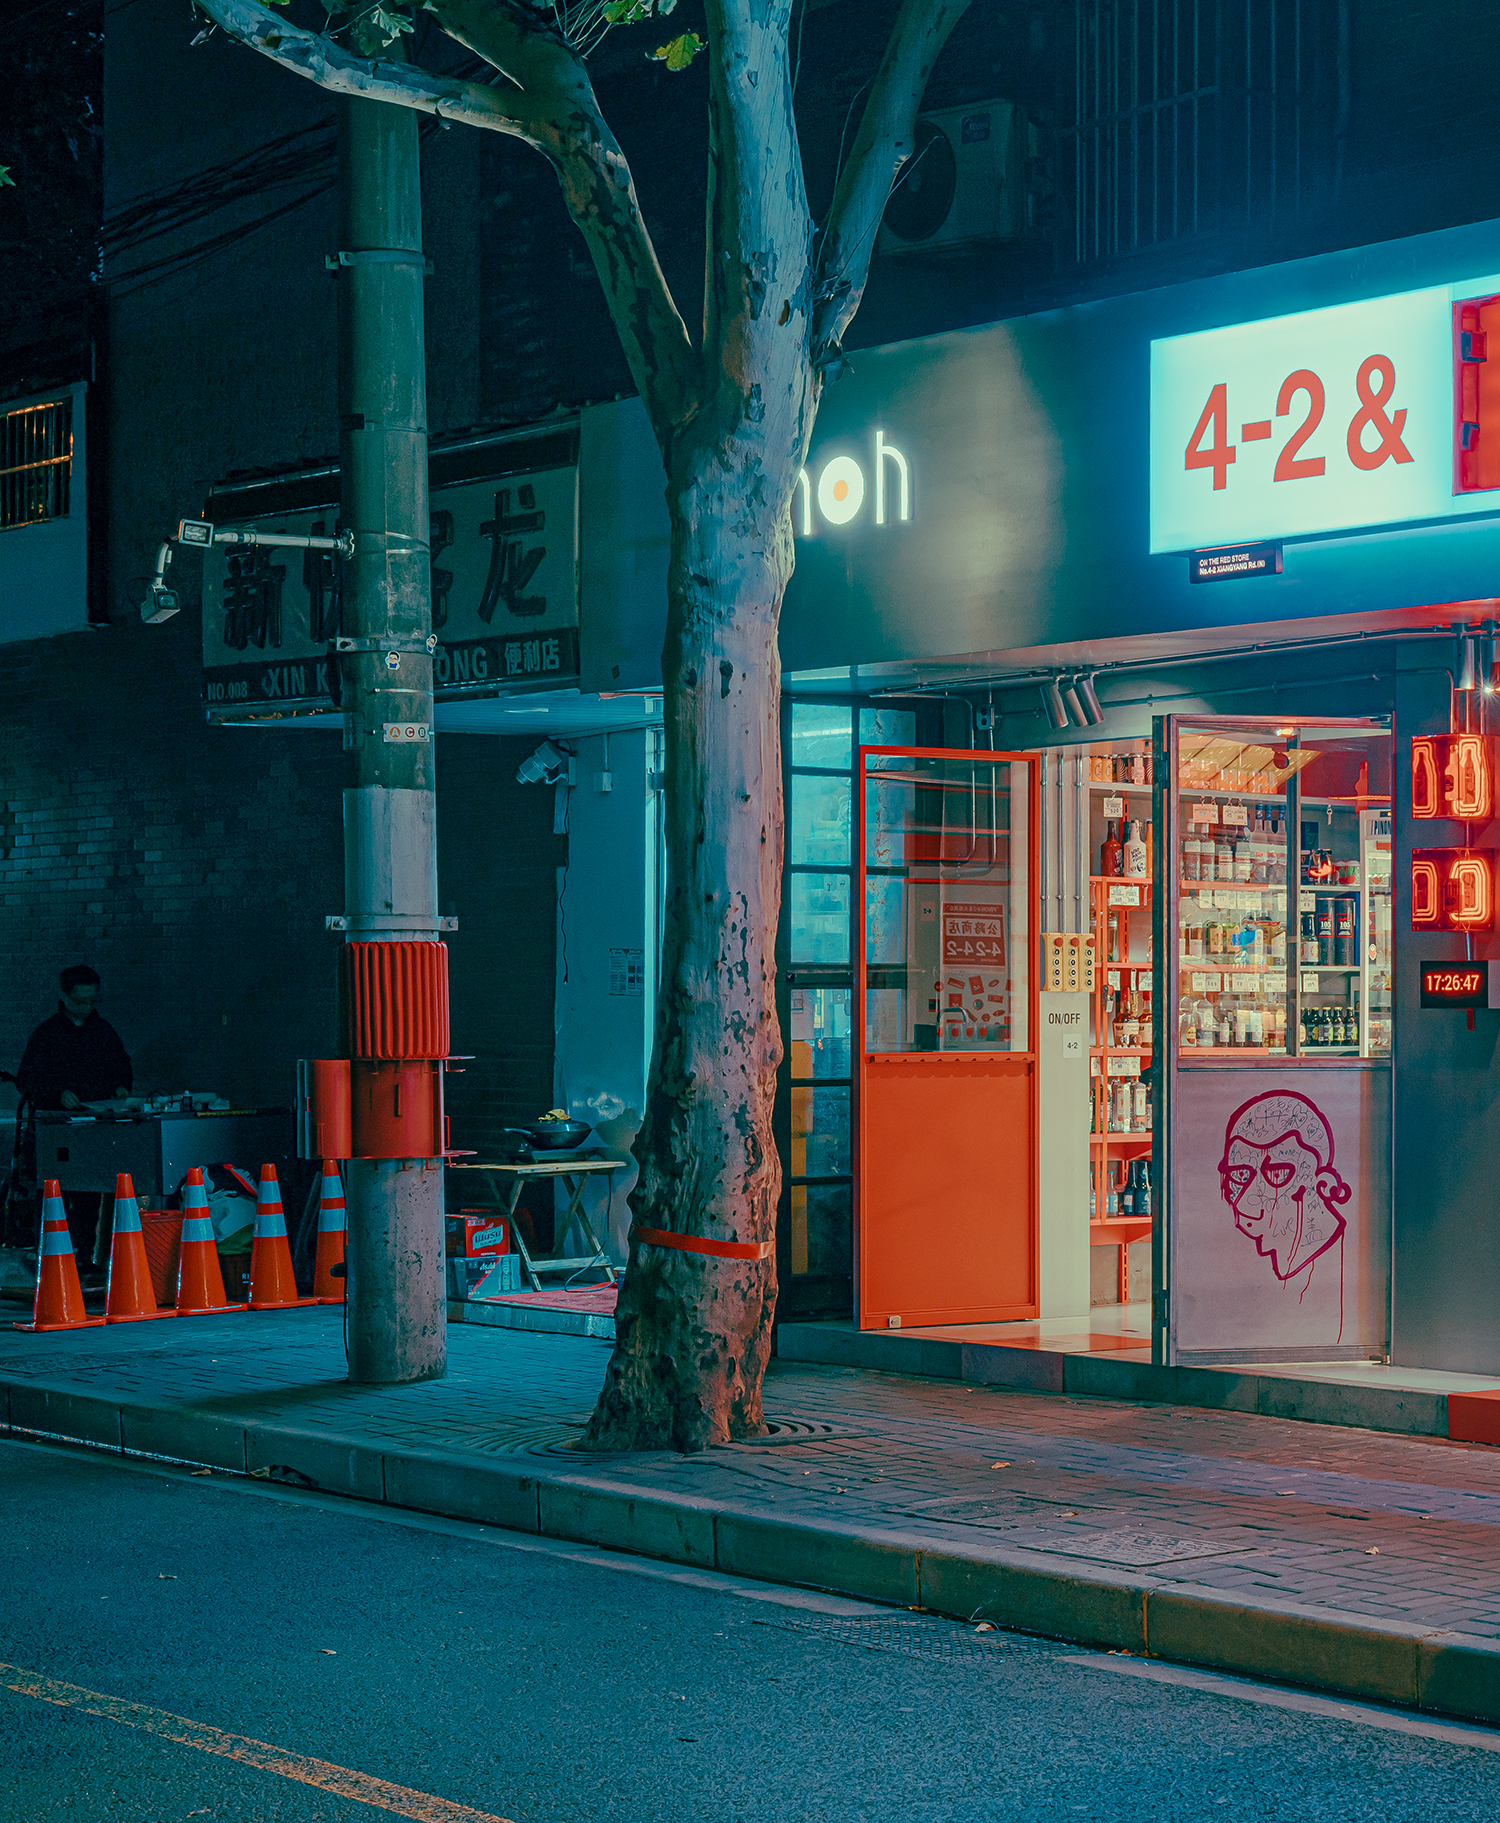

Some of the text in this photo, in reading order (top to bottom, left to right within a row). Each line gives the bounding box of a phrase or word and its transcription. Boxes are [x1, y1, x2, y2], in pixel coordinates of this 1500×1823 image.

[1185, 354, 1415, 491] 4-2 &
[266, 664, 306, 698] XIN
[437, 646, 489, 683] ONG
[503, 637, 561, 676] 便利店
[1426, 974, 1480, 991] 17:26:47
[1048, 1012, 1080, 1025] ON/OFF
